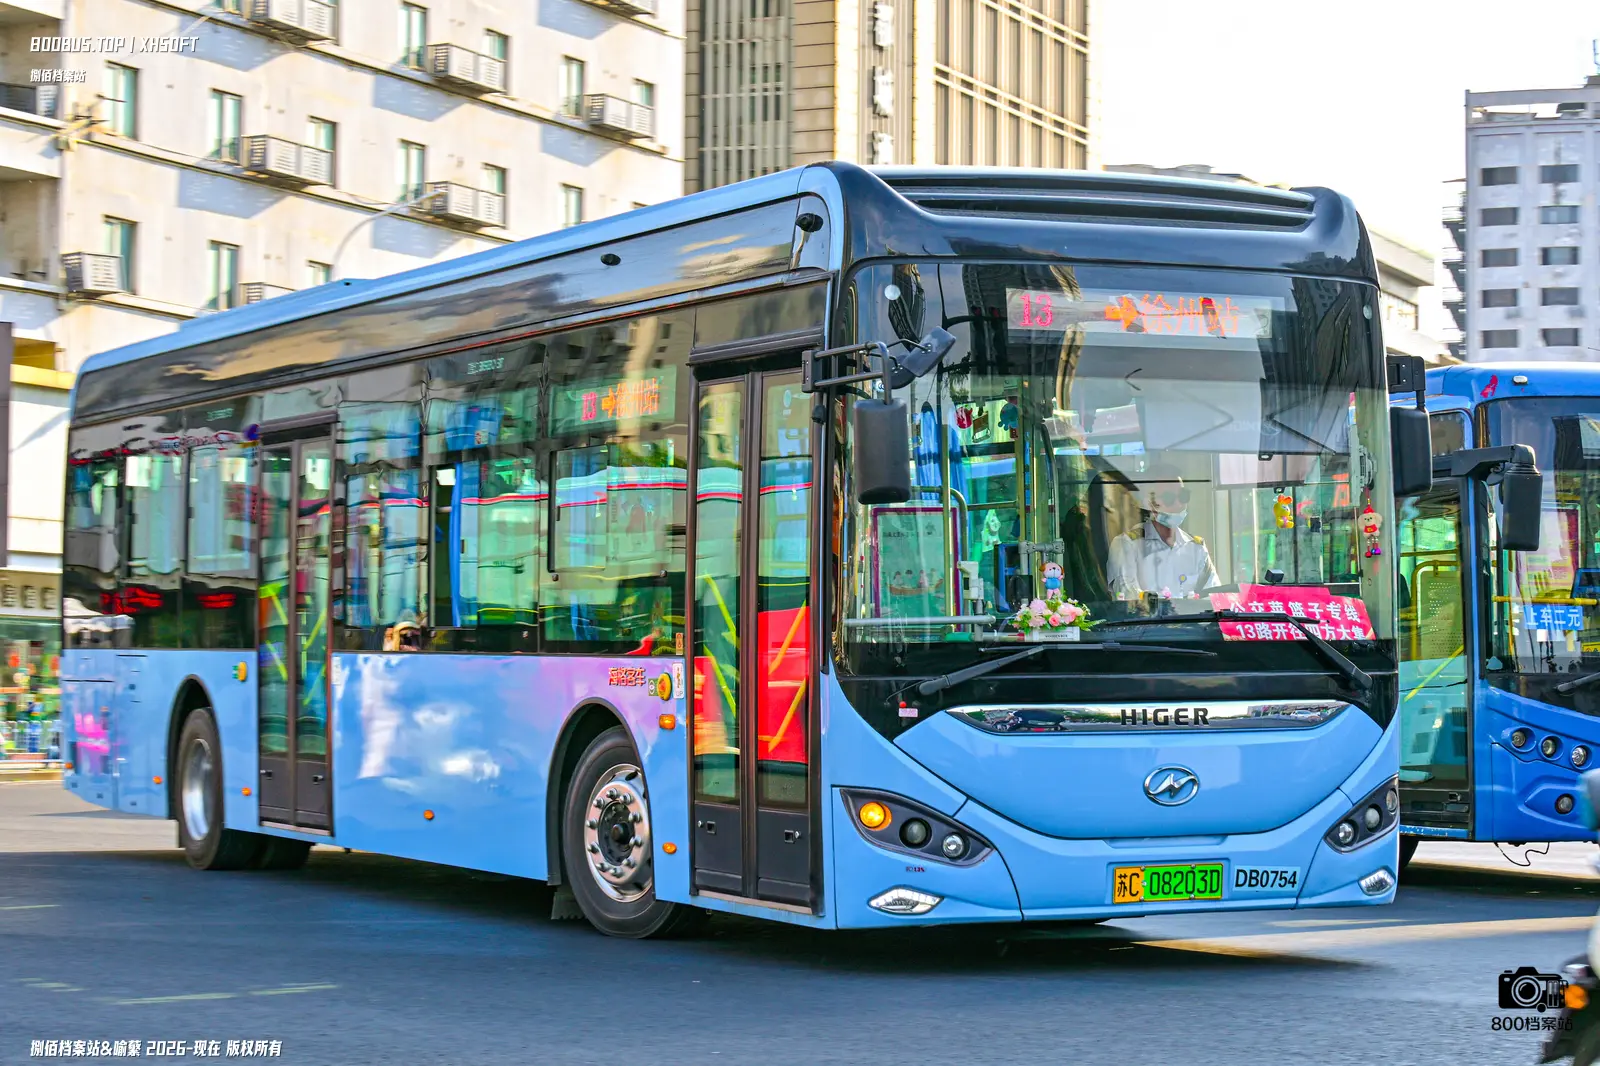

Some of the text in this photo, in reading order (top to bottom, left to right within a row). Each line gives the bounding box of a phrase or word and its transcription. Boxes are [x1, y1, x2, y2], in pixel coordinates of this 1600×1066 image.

[1019, 294, 1053, 327] 13
[1139, 293, 1239, 336] 徐州站
[1526, 607, 1581, 627] 上车二元
[1236, 621, 1366, 641] 13路开往四方大集
[1120, 708, 1210, 727] HIGER
[1234, 868, 1298, 889] DB0754
